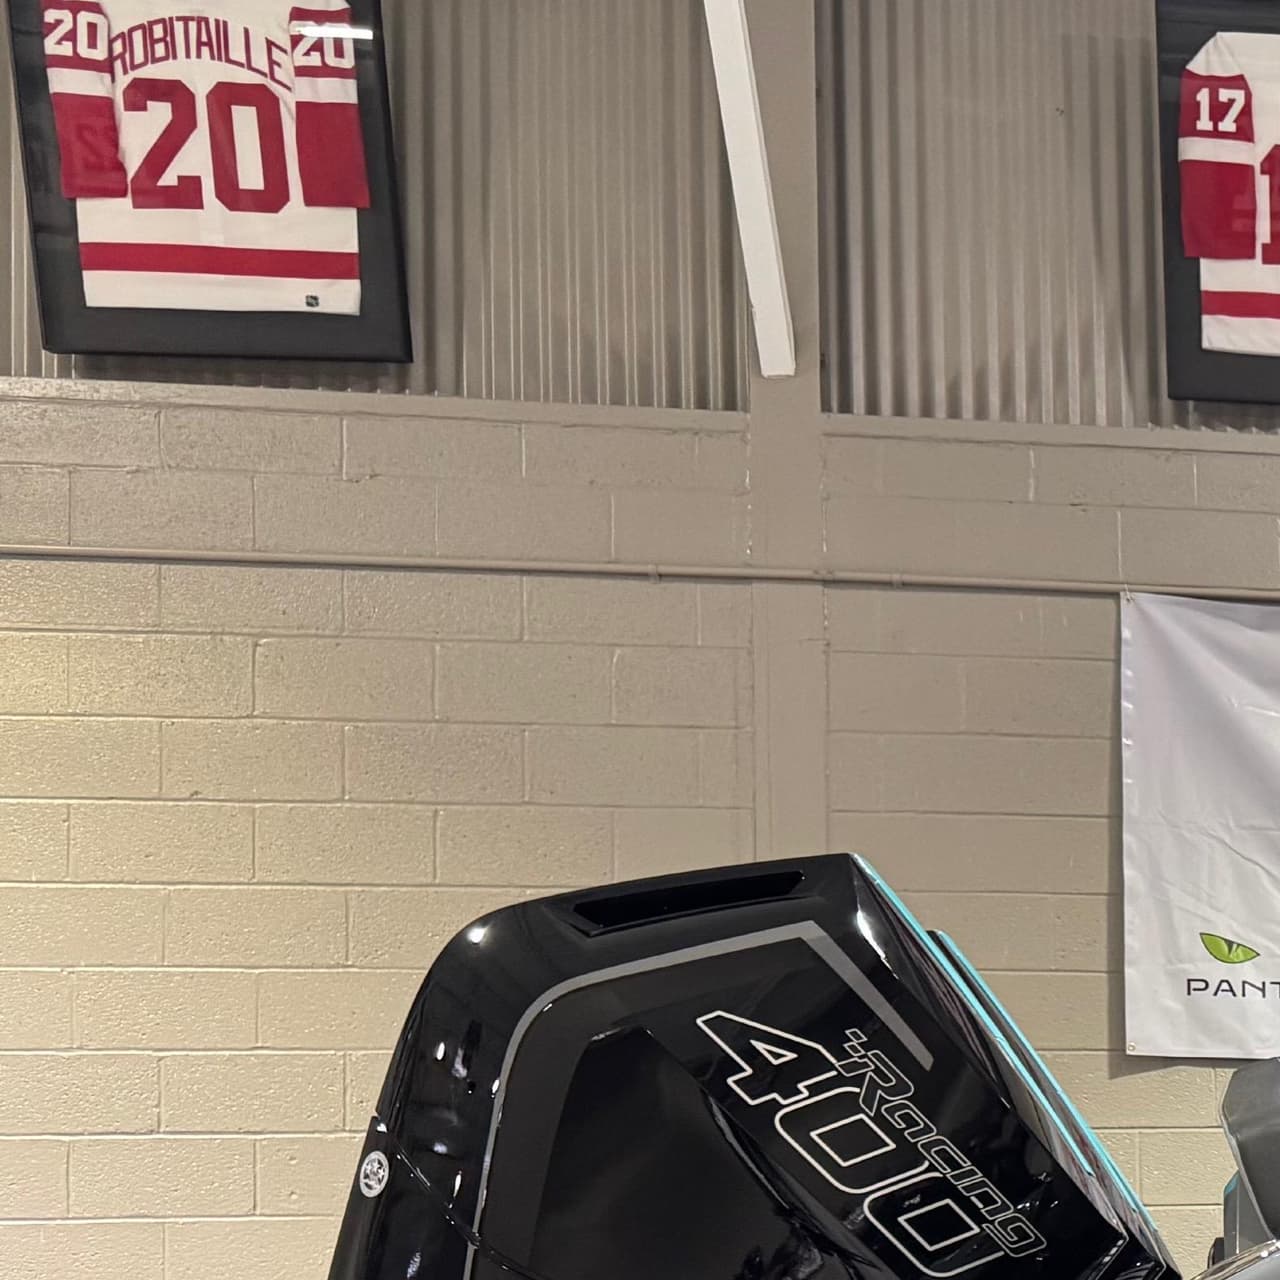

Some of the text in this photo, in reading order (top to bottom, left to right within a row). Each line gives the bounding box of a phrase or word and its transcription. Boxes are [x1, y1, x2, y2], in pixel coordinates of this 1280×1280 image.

[43, 9, 109, 61] 20
[110, 15, 293, 91] ROBITAILLE
[289, 20, 355, 69] 20
[122, 77, 290, 214] 20
[1196, 87, 1246, 132] 17
[695, 1010, 1006, 1278] 400
[835, 1042, 1048, 1258] Racing
